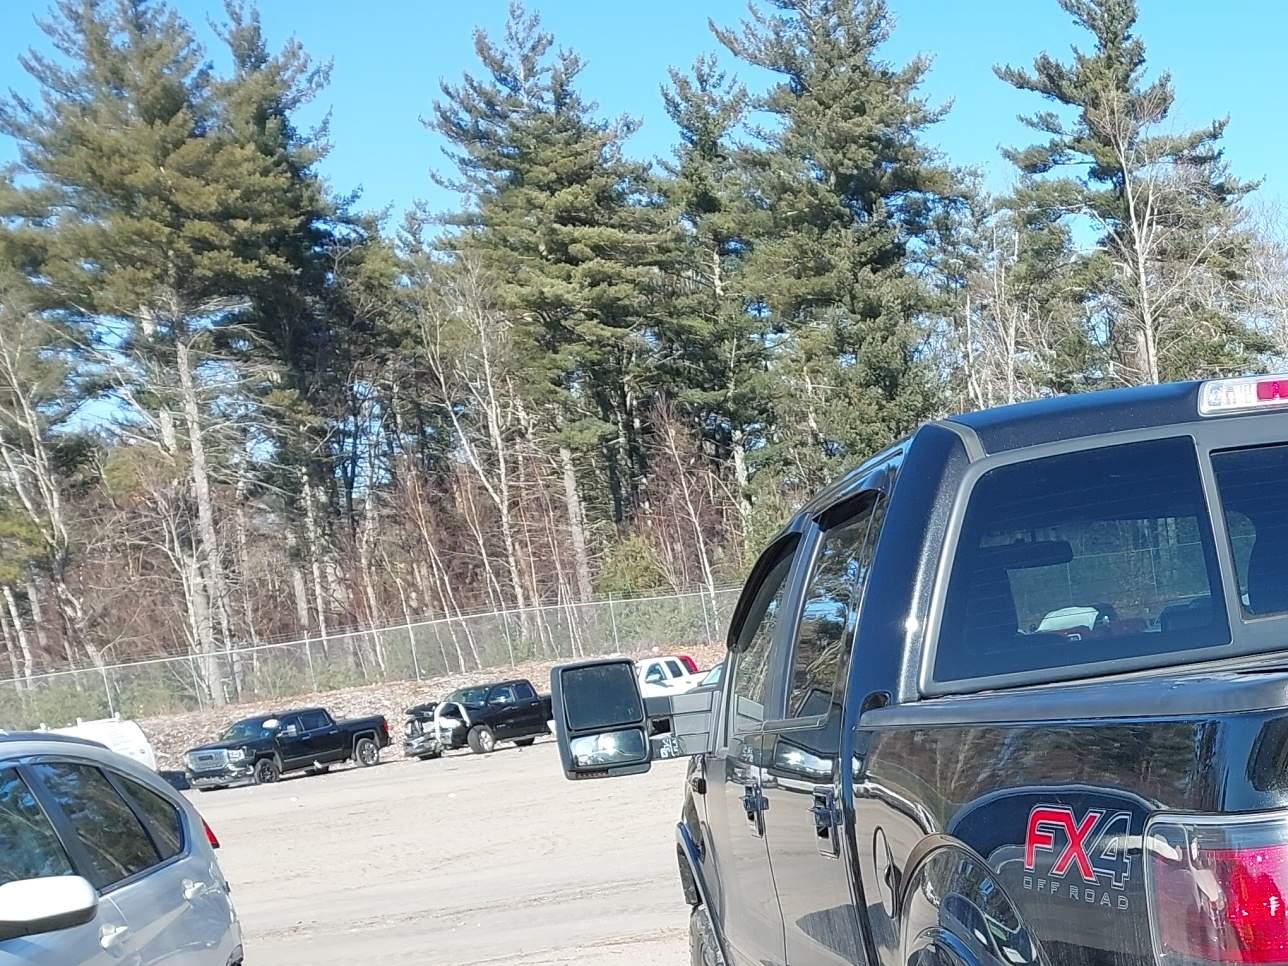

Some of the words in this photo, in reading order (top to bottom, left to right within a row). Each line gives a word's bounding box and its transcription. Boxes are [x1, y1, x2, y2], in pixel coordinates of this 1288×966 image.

[1024, 804, 1132, 890] FX4
[1023, 876, 1060, 895] OFF
[1069, 885, 1129, 911] ROAD
